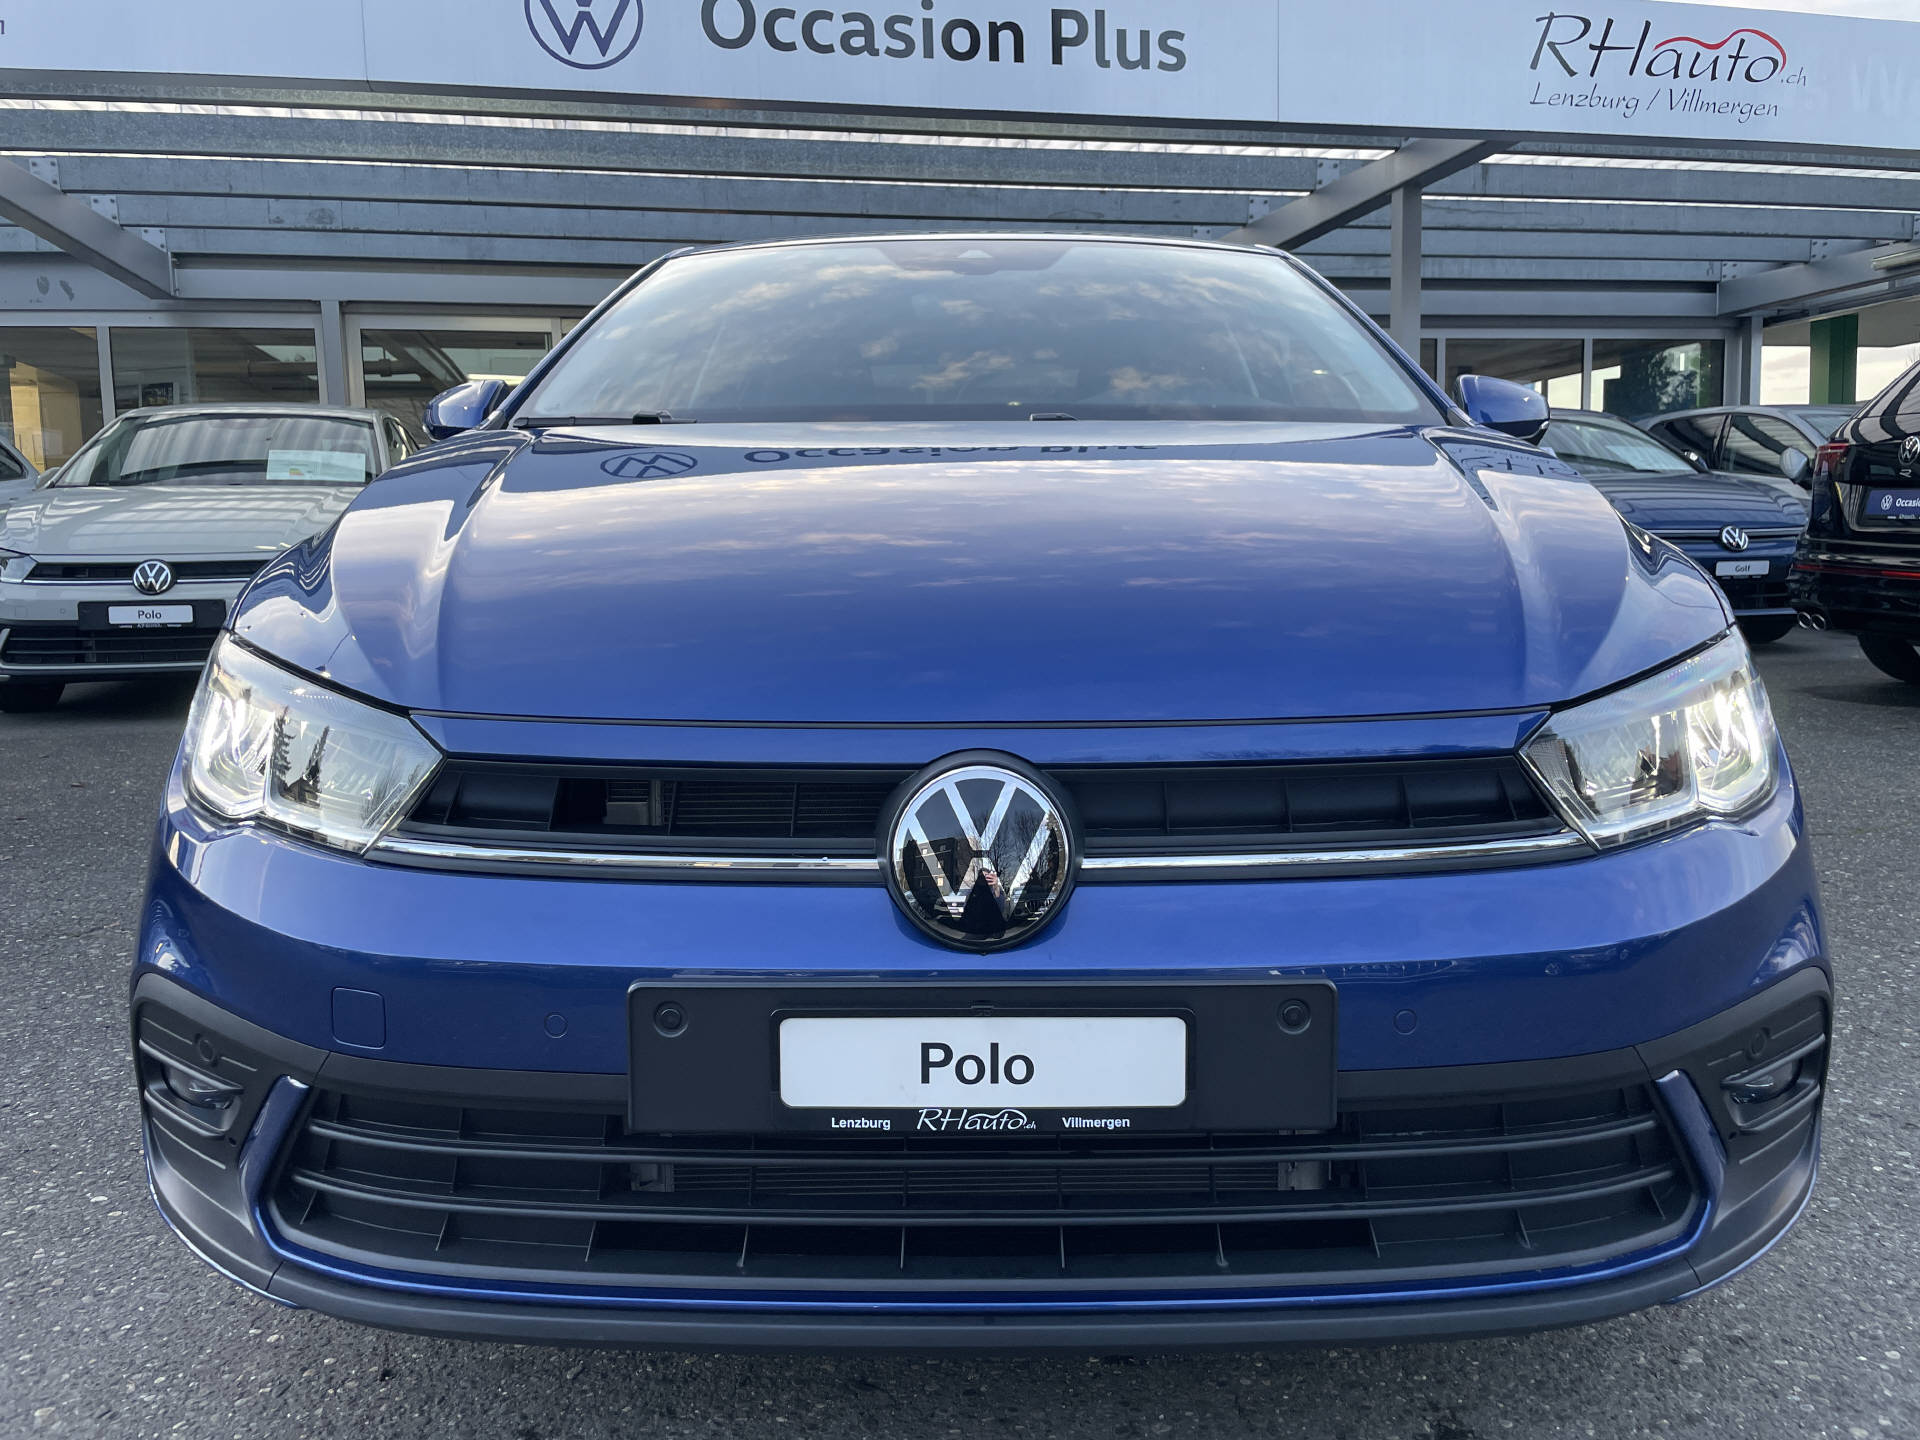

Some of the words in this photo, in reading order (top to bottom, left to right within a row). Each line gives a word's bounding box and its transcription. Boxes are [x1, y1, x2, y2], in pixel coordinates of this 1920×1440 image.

[700, 0, 1024, 63] Occasion
[1051, 8, 1187, 72] Plus
[1529, 82, 1640, 119] Lenzburg
[1668, 88, 1778, 124] Villmergen
[1734, 564, 1751, 573] Golf
[137, 609, 162, 619] Polo
[920, 1042, 1035, 1085] Polo
[831, 1117, 891, 1131] Lenzburg
[1062, 1116, 1131, 1130] Villmergen
